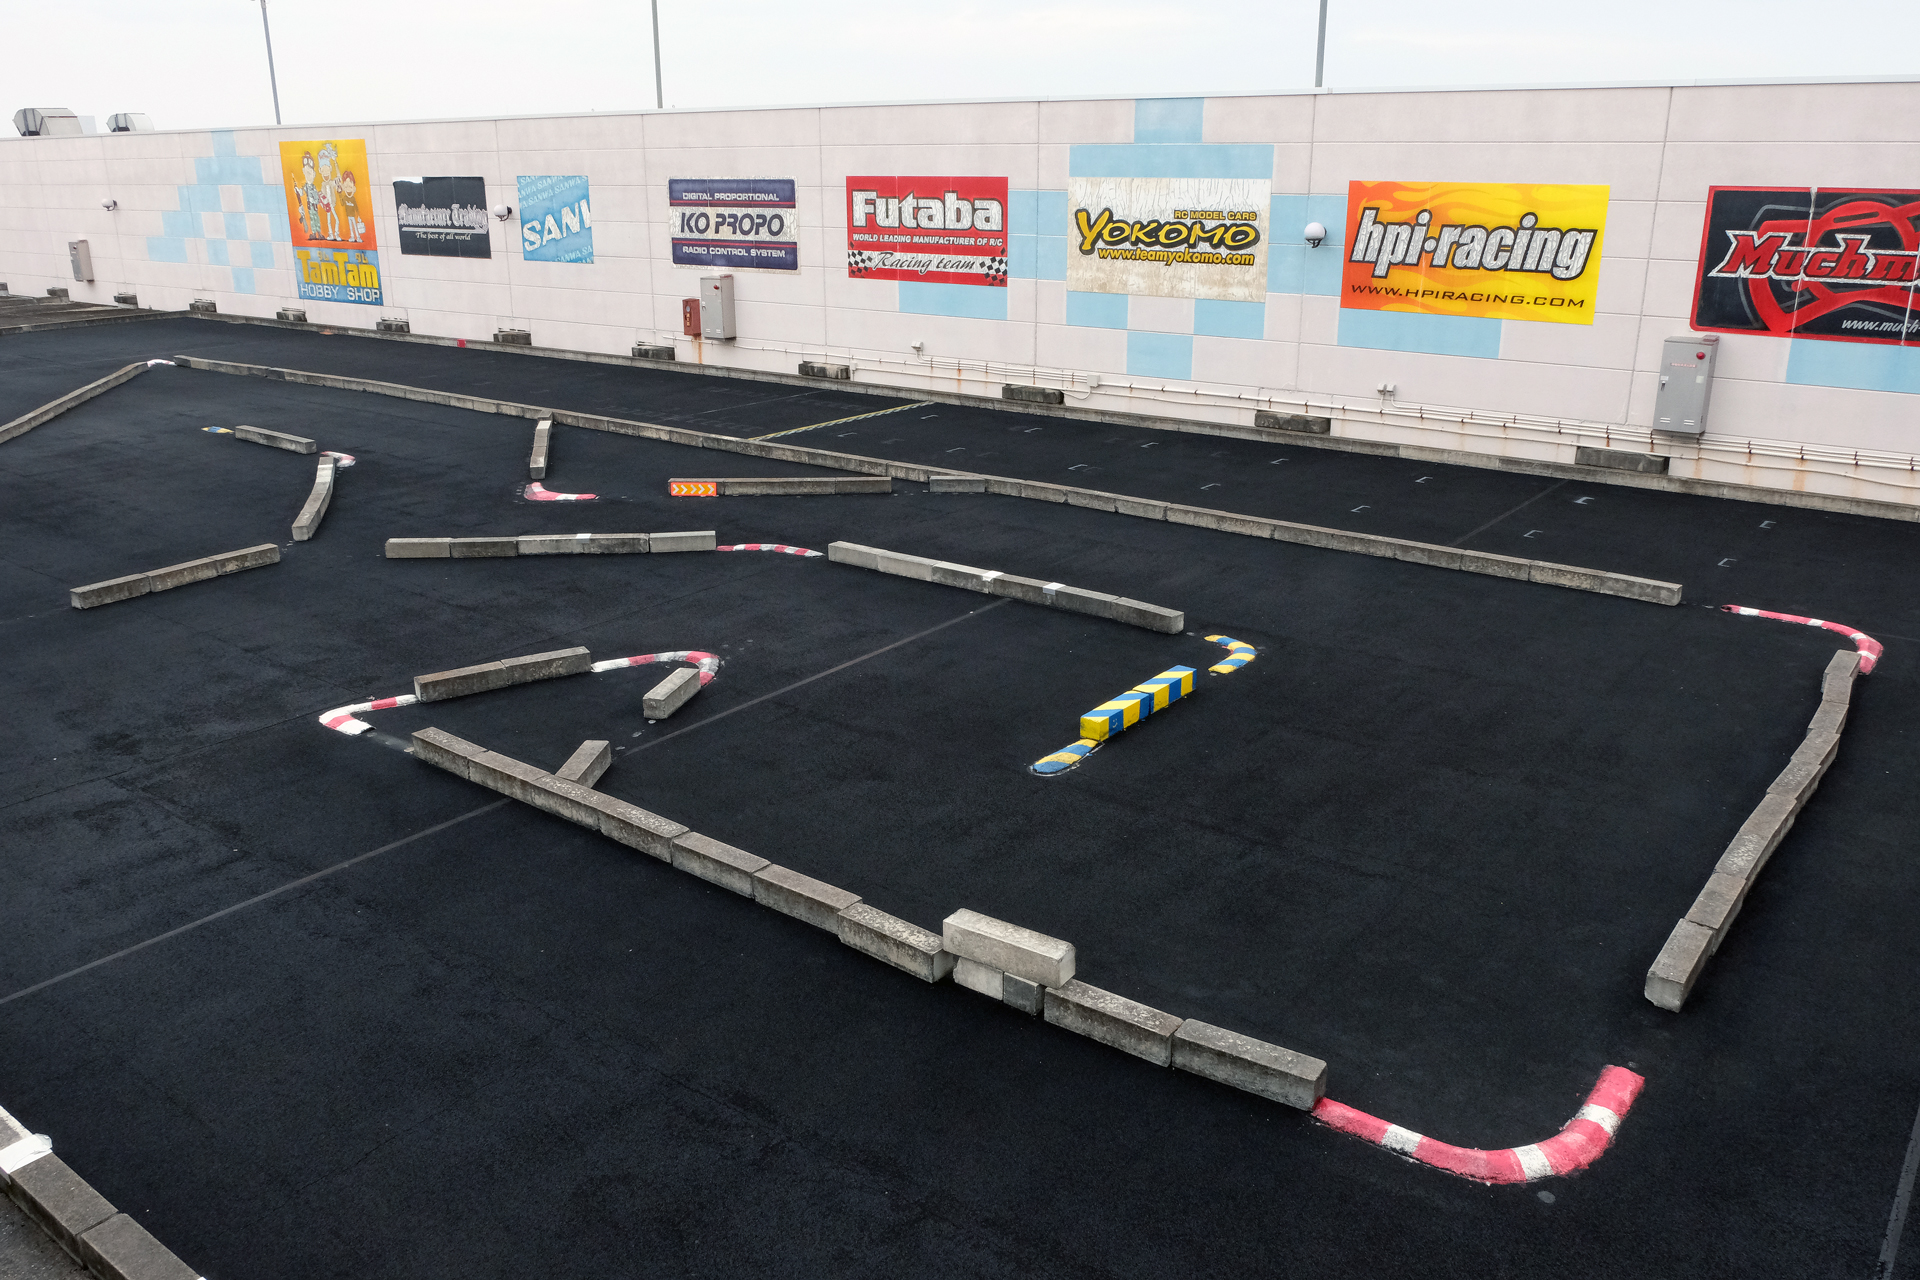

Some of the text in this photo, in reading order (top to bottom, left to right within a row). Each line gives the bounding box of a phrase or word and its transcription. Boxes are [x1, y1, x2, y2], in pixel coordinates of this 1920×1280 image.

[528, 189, 554, 205] SANWA
[554, 177, 580, 194] SANWA
[682, 192, 779, 201] DIGITAL PROPORTIONAL
[852, 189, 1004, 232] Futaba
[1174, 210, 1256, 221] RC MODEL CARS
[681, 212, 784, 236] KO PROPO
[852, 233, 1003, 246] WORLD LEADING MANUFACTURER OF R/C
[683, 246, 785, 257] RADIO CONTROL SYSTEM
[1097, 247, 1254, 266] www.teamyokomo.com
[296, 250, 379, 288] TamTam
[874, 252, 976, 275] Racing team
[300, 284, 380, 302] HOBBY SHOP
[1352, 284, 1585, 308] WWW.HPIRACING.COM
